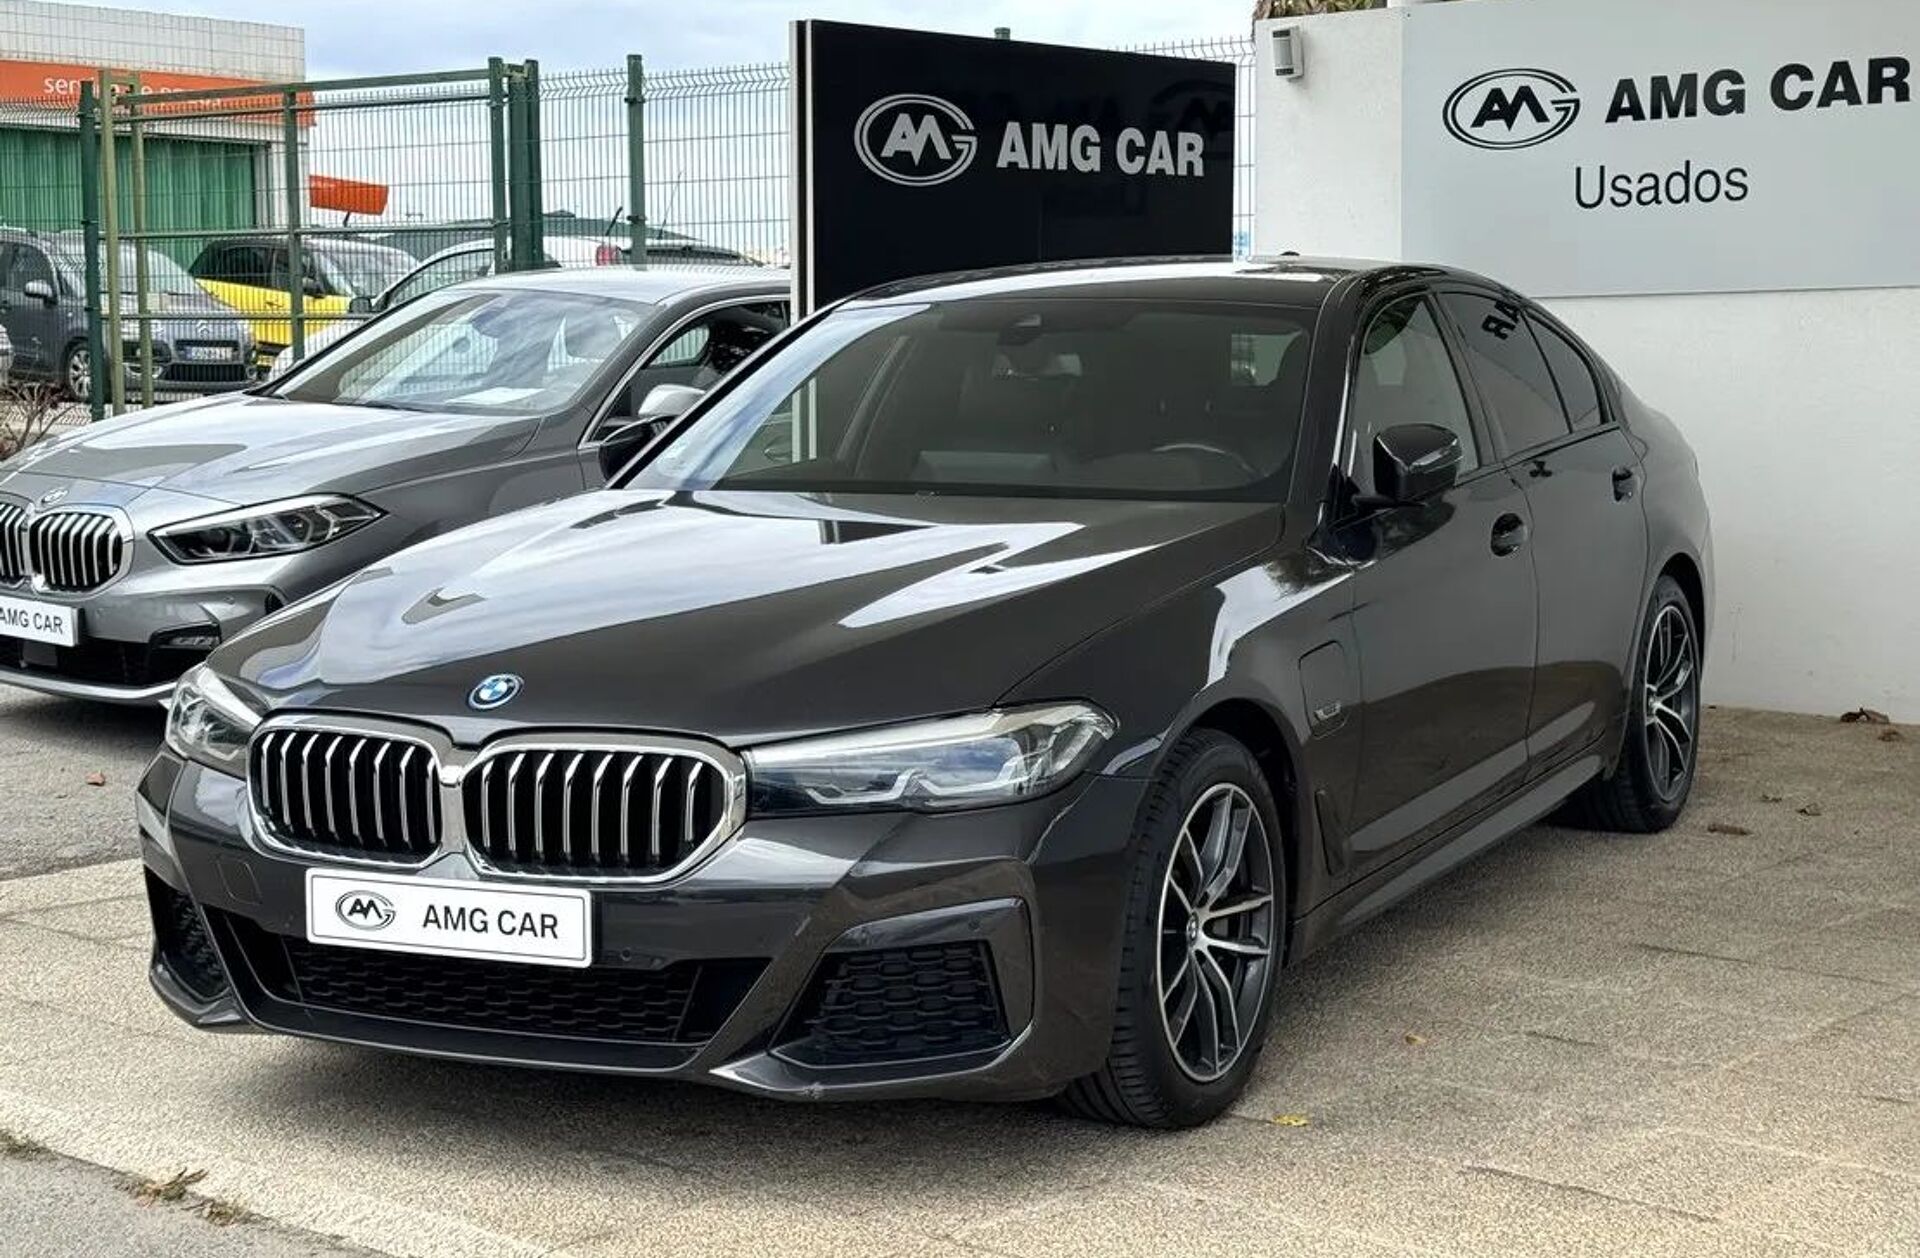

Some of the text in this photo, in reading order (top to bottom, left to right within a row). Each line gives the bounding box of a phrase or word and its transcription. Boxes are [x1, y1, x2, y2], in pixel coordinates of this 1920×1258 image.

[1604, 68, 1746, 123] AMG
[1769, 56, 1911, 111] CAR
[996, 121, 1101, 172] AMG
[1116, 127, 1205, 177] CAR
[1574, 160, 1749, 209] Usados
[33, 612, 63, 634] CAR
[423, 904, 489, 933] AMG
[497, 910, 559, 939] CAR
